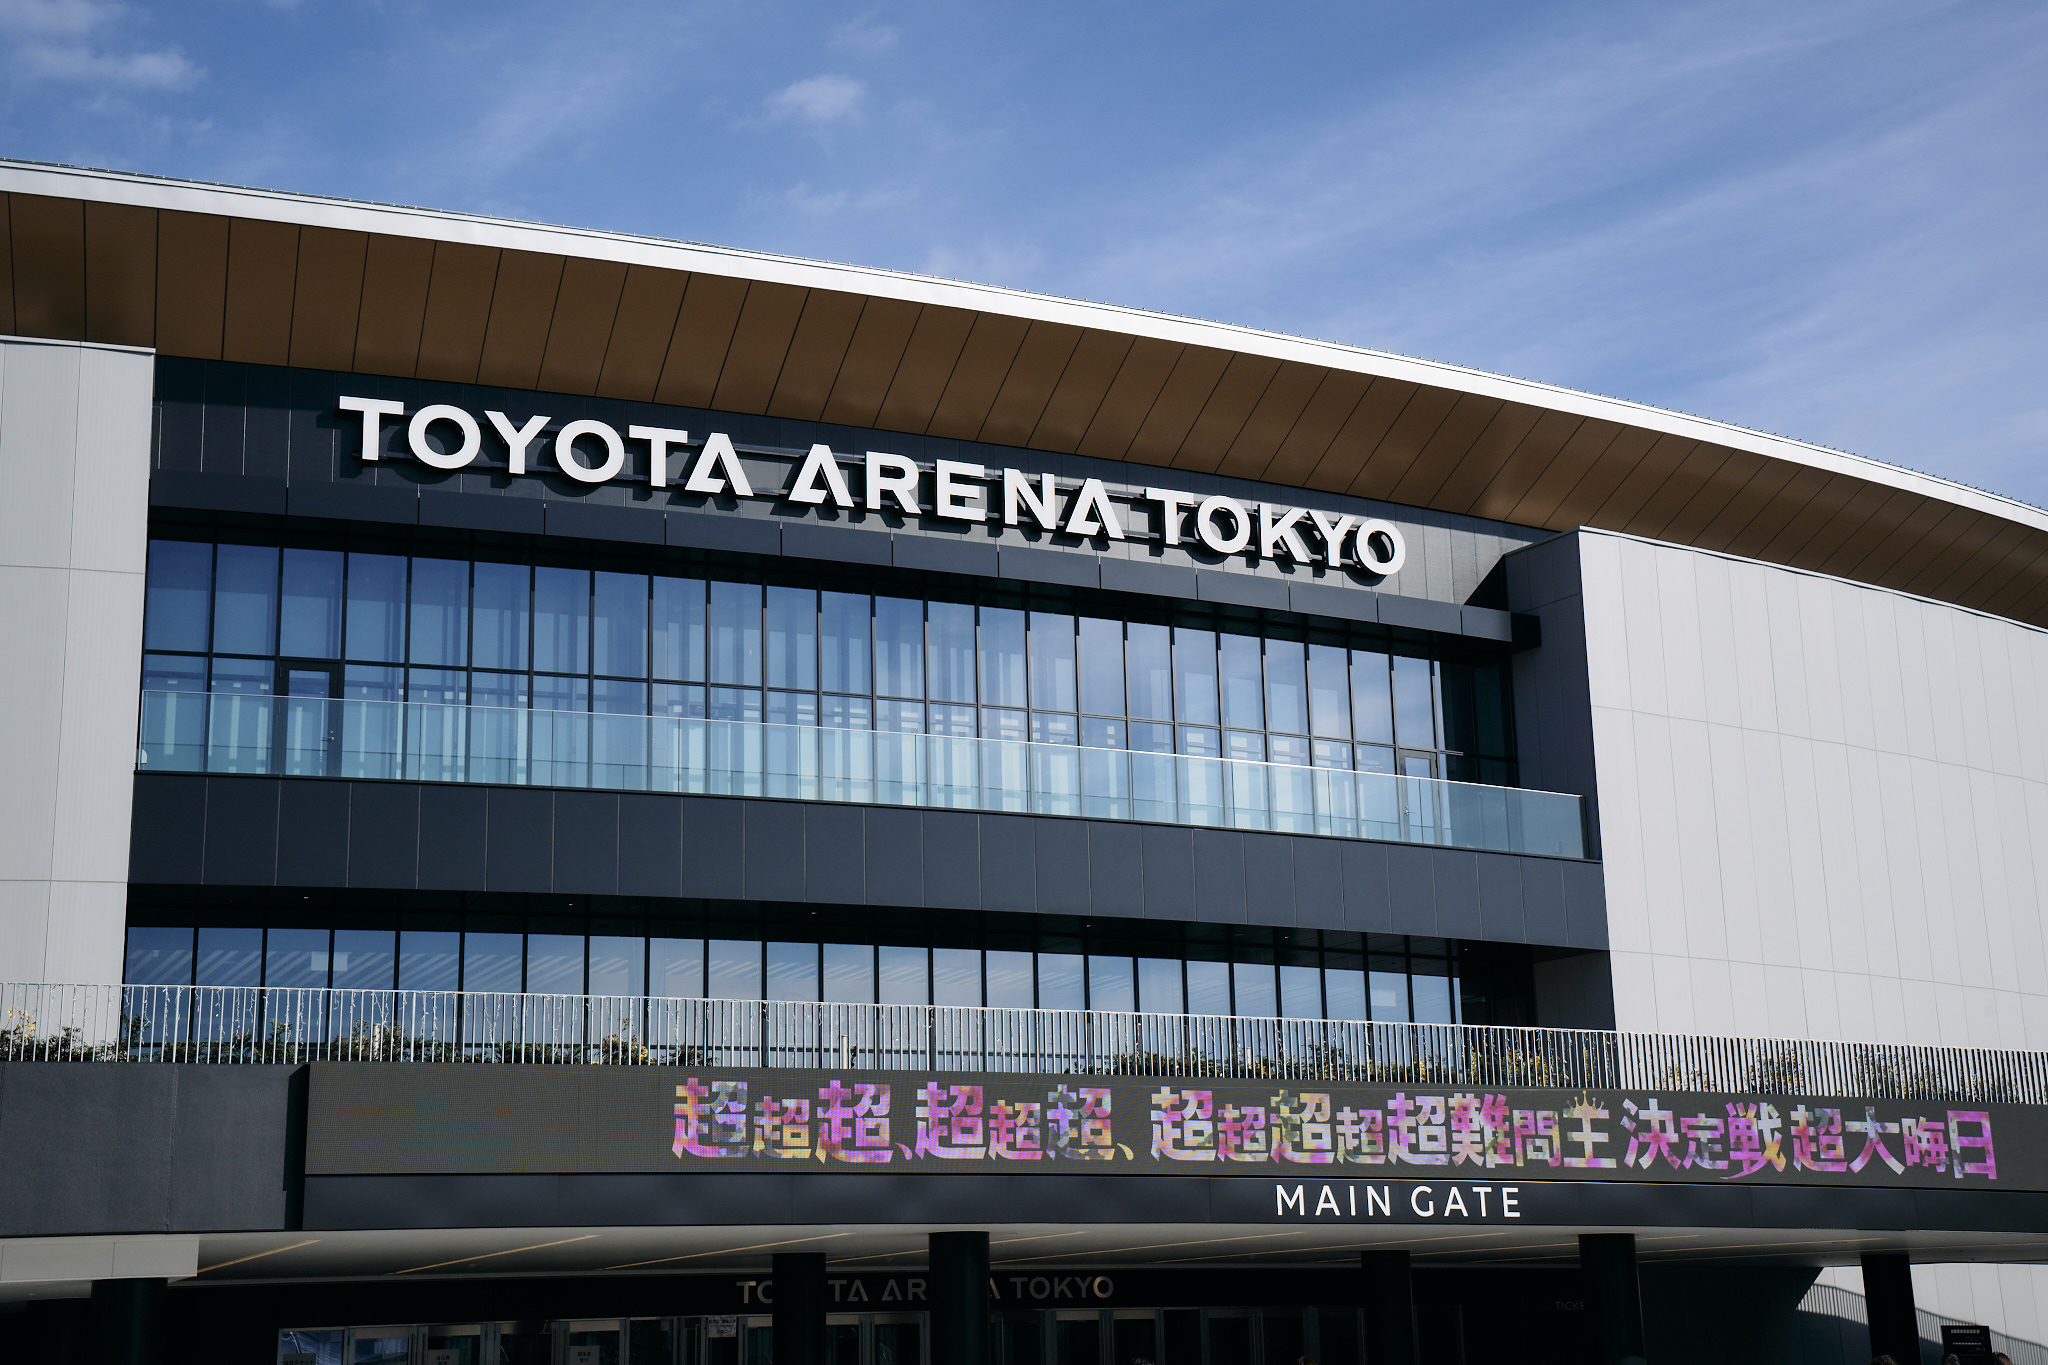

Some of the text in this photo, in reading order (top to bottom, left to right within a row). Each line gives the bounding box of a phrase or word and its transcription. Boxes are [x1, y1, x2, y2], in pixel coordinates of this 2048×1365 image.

[339, 395, 1407, 576] TOYOTA ARENA TOKYO
[1276, 1184, 1521, 1218] MAIN GATE
[735, 1279, 869, 1304] TOTA
[1009, 1275, 1114, 1300] TOKYO
